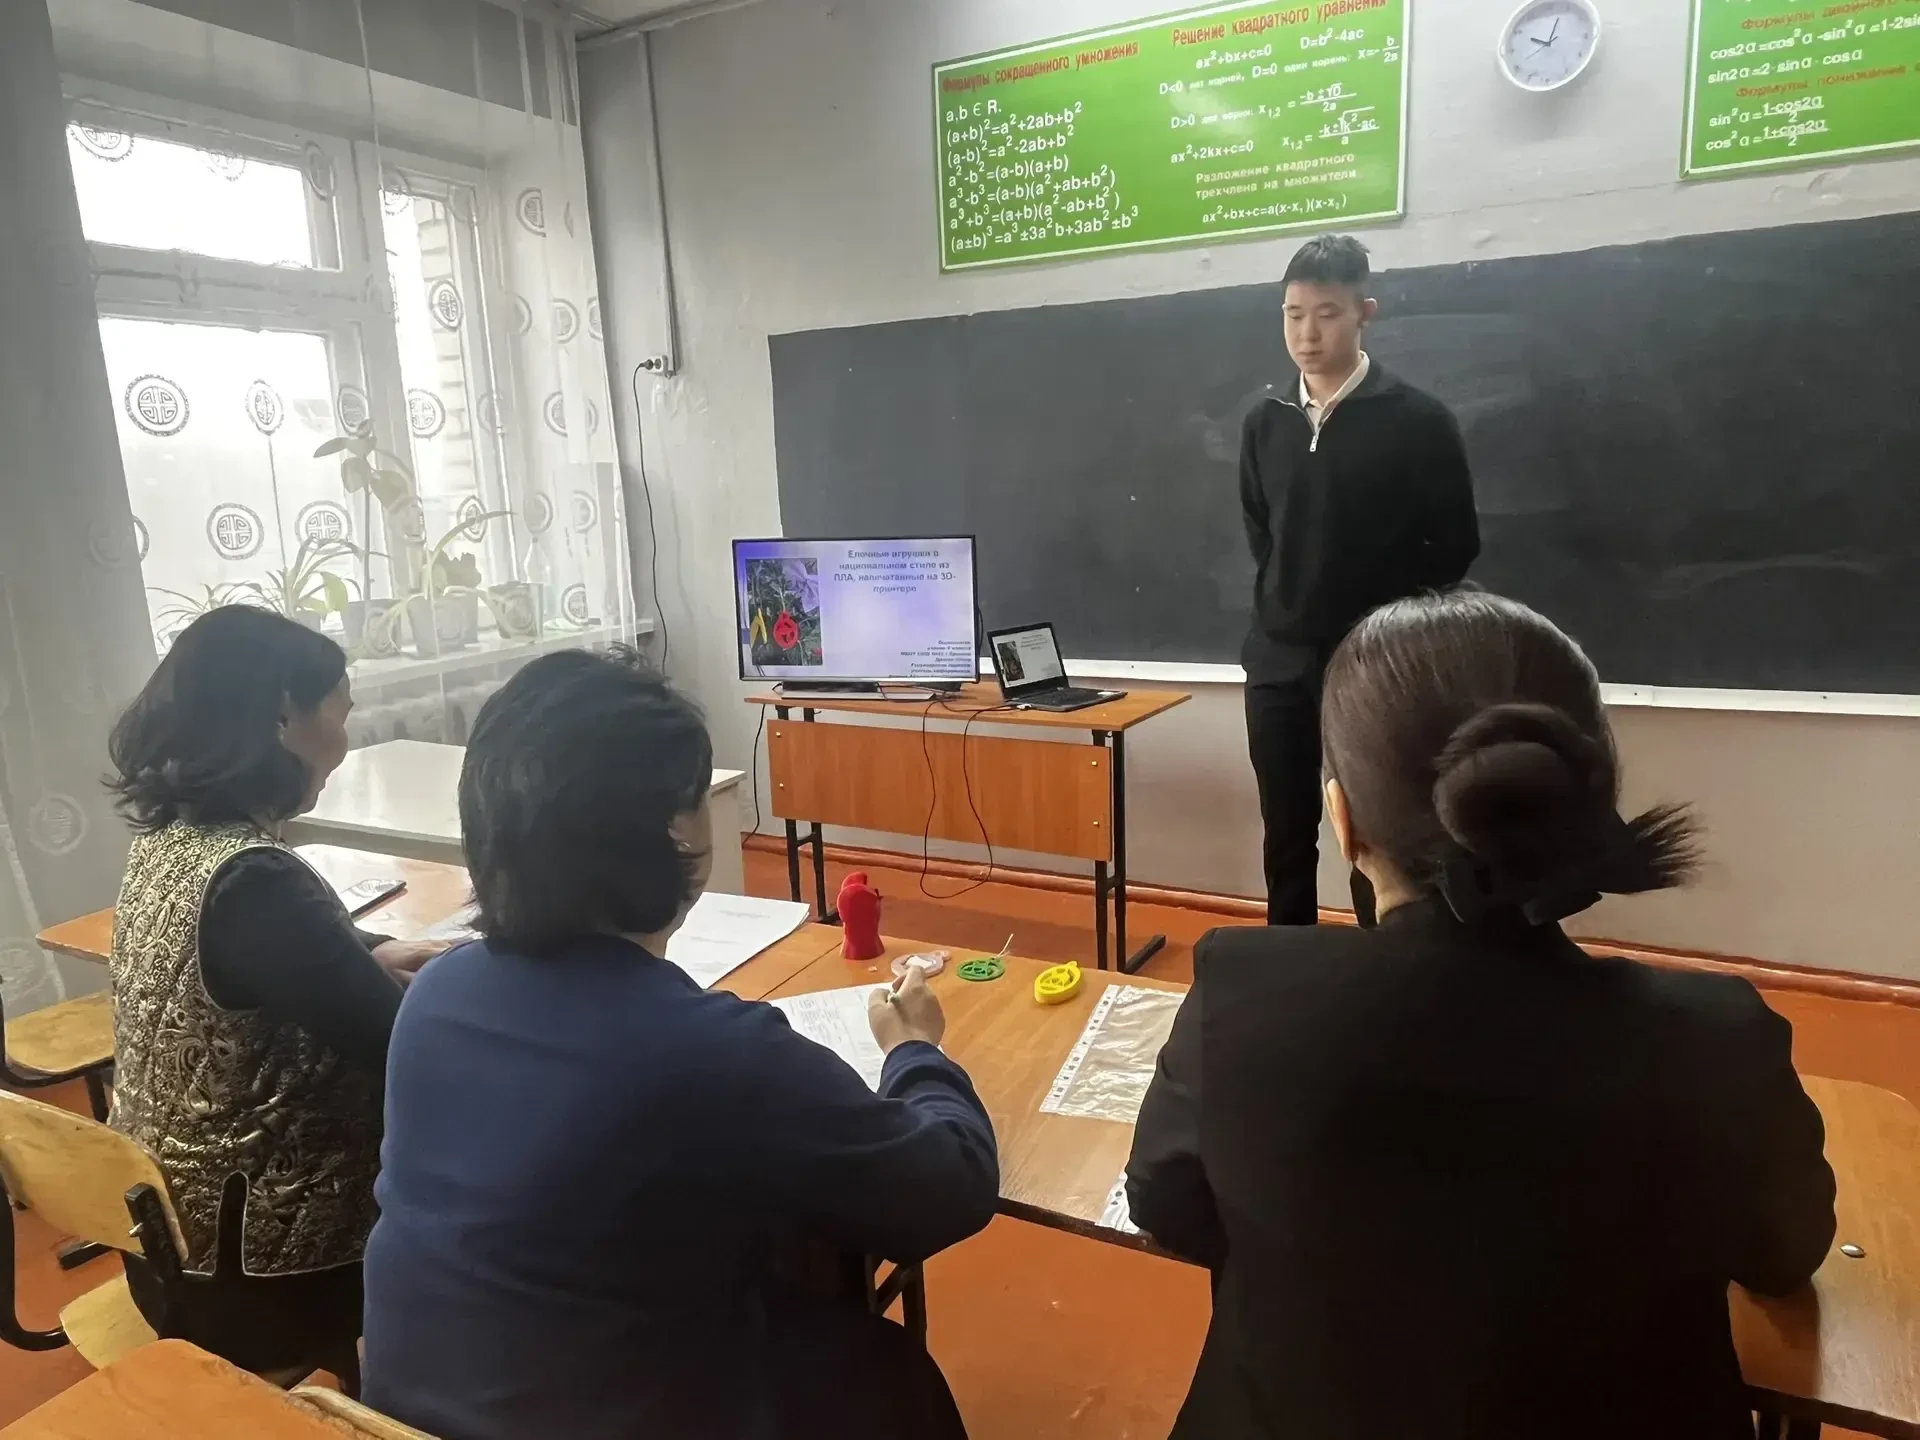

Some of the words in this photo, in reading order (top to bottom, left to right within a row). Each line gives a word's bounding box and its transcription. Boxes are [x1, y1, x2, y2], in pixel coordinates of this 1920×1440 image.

[1172, 24, 1225, 47] Решение
[1232, 7, 1309, 34] квадратного
[995, 55, 1069, 84] сокращенного
[1075, 42, 1139, 71] умножения
[1196, 165, 1269, 184] Разложение
[1276, 153, 1355, 172] квадратного
